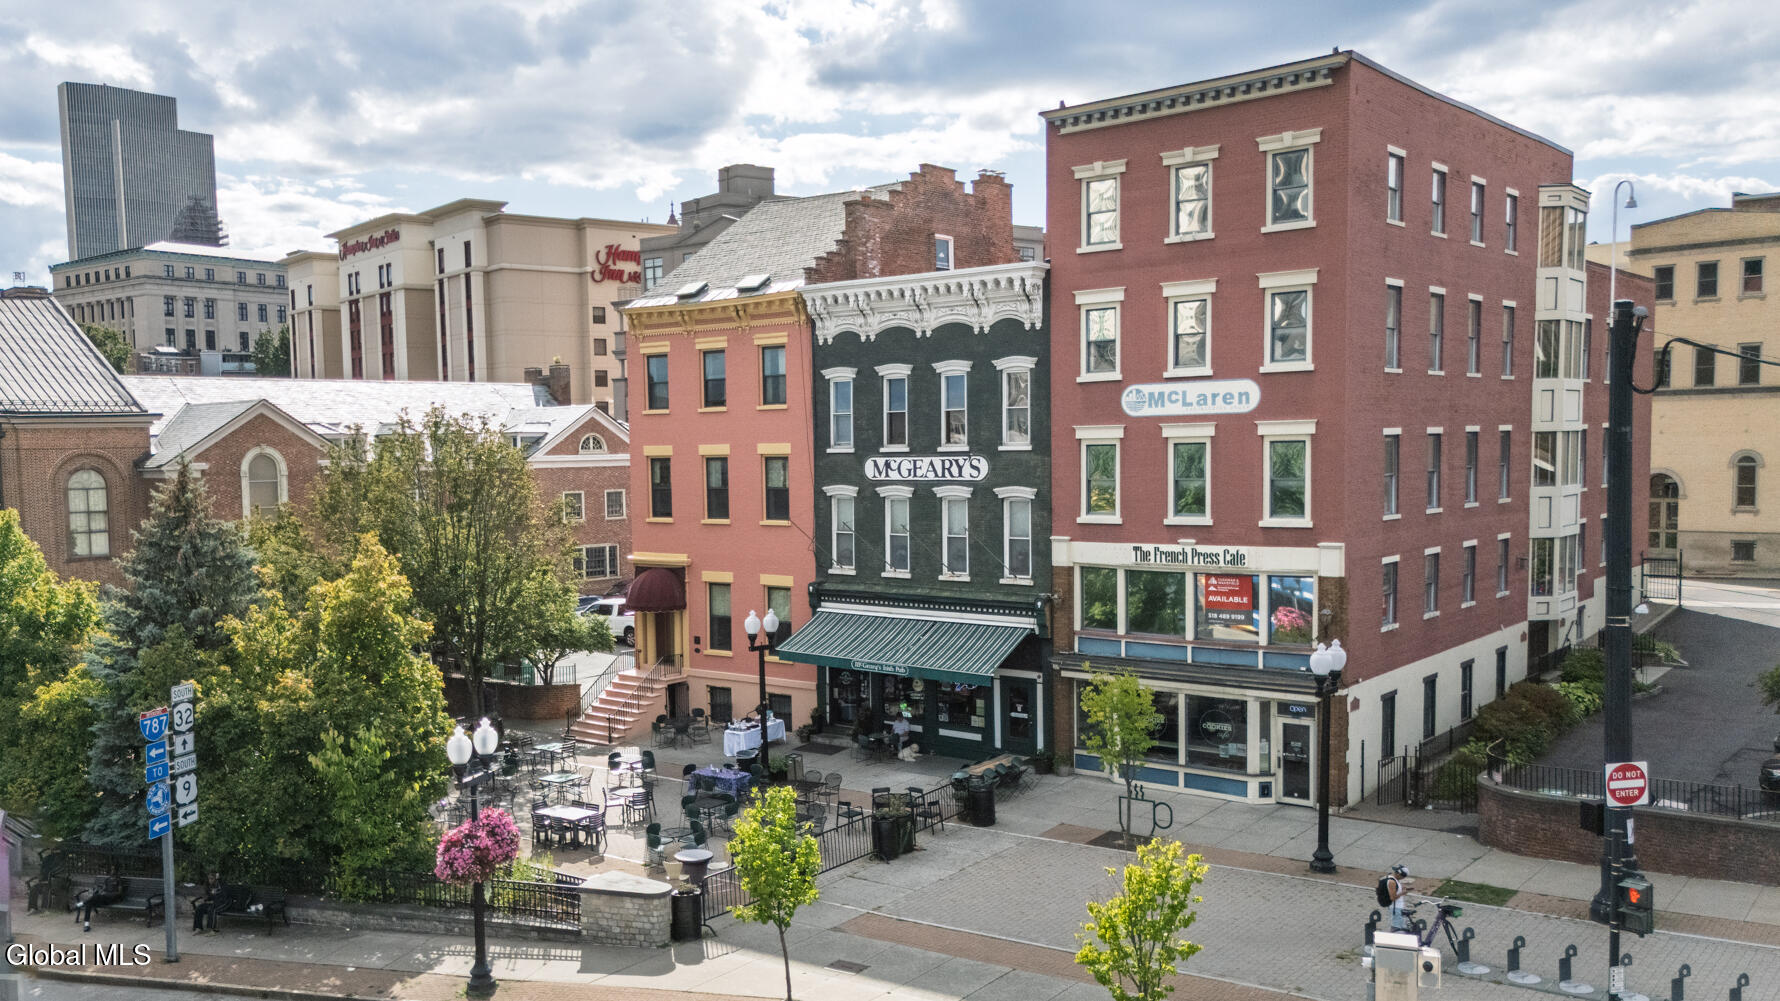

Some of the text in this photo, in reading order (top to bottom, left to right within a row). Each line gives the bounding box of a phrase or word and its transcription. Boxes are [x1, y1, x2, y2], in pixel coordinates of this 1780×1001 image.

[1147, 390, 1250, 408] McLaren
[1132, 546, 1246, 566] The French Press Cafe
[1208, 595, 1248, 603] AVAILABLE
[174, 687, 192, 699] SOUTH
[175, 707, 193, 727] 32
[143, 716, 167, 735] 787
[176, 757, 196, 770] SOUTH
[152, 766, 163, 777] TO
[1625, 770, 1641, 778] NOT
[183, 780, 191, 797] 9
[1615, 789, 1639, 798] ENTER
